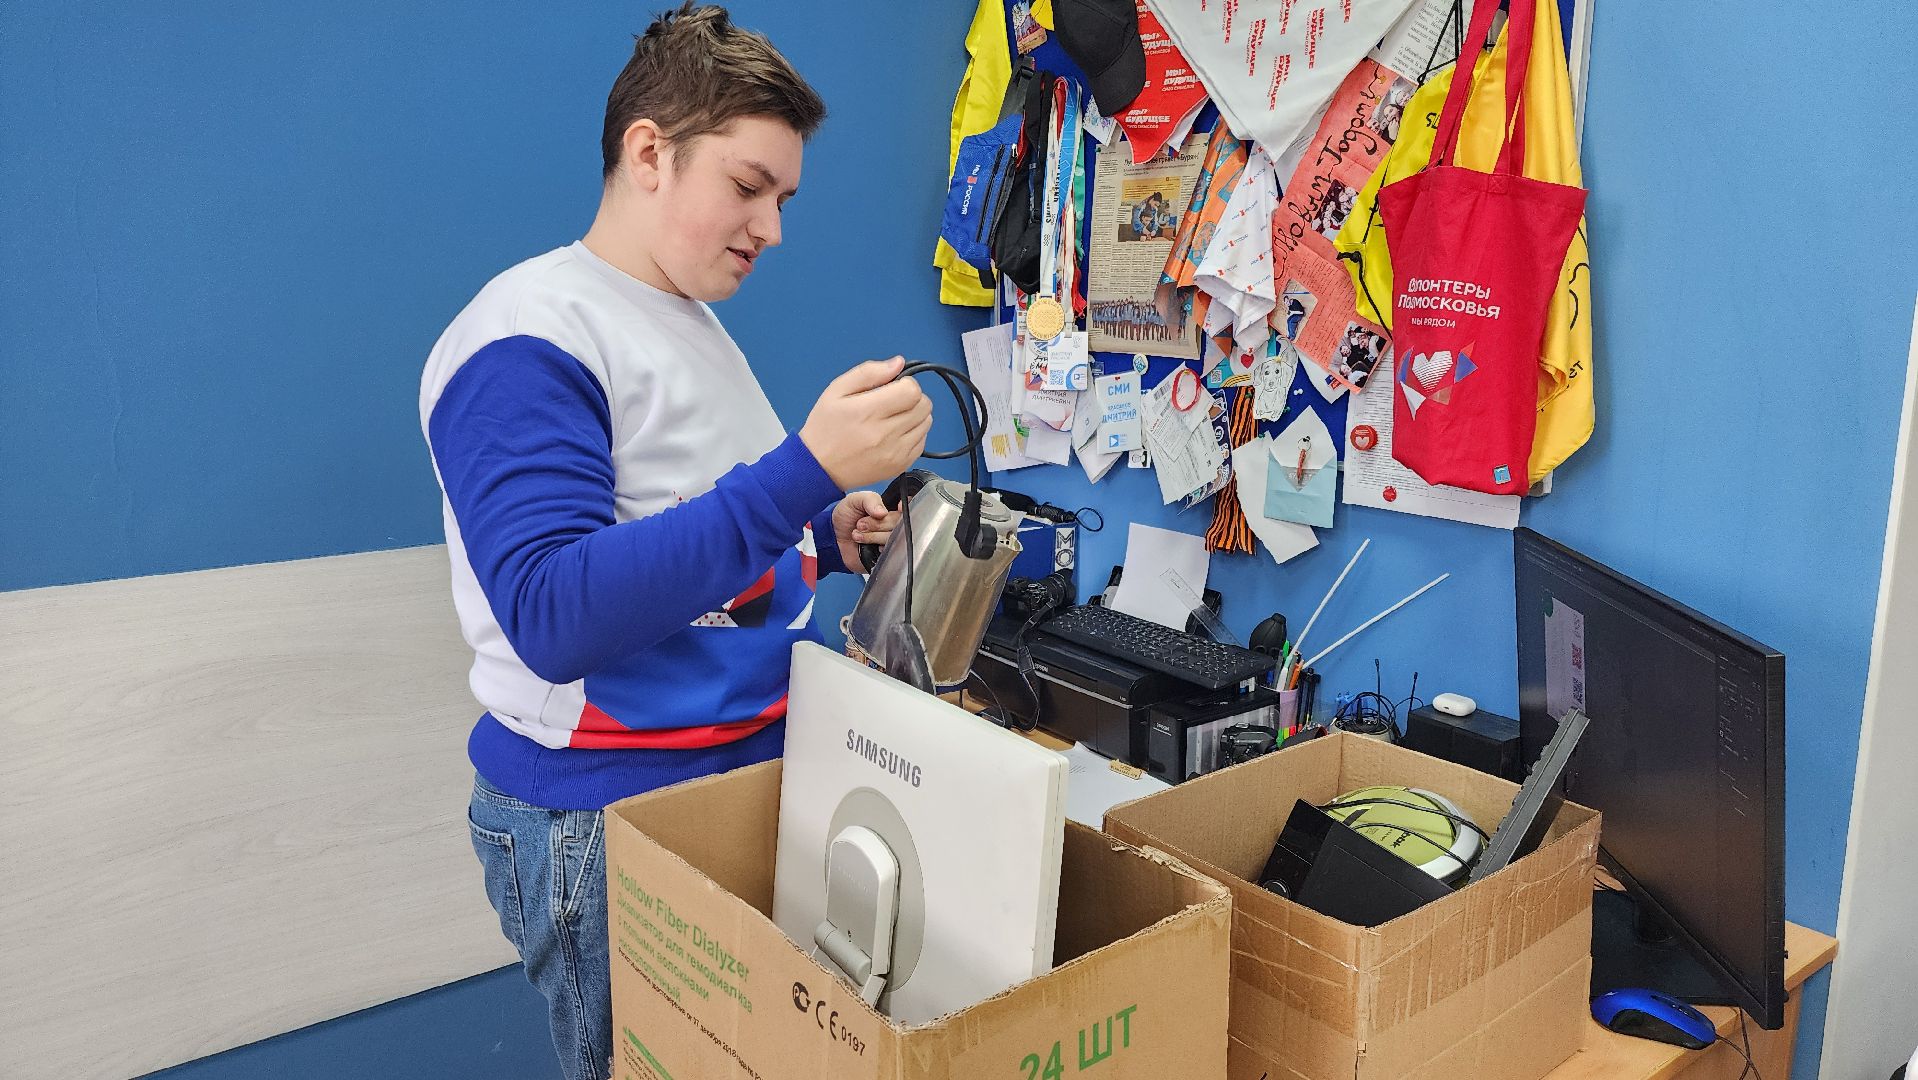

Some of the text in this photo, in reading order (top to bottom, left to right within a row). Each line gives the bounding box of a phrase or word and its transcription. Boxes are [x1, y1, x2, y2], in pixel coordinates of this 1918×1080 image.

[961, 185, 973, 215] РОССИЯ
[1408, 277, 1491, 300] ВЛОНТЕРЫ
[1424, 318, 1456, 328] РЯДОМ
[1107, 382, 1131, 396] СМИ
[846, 728, 922, 788] SAMSUNG
[617, 864, 750, 983] Hollow Fiber Dialyzer
[665, 938, 685, 959] для
[841, 1025, 866, 1057] 0197
[1019, 1003, 1138, 1080] 24 ШТ
